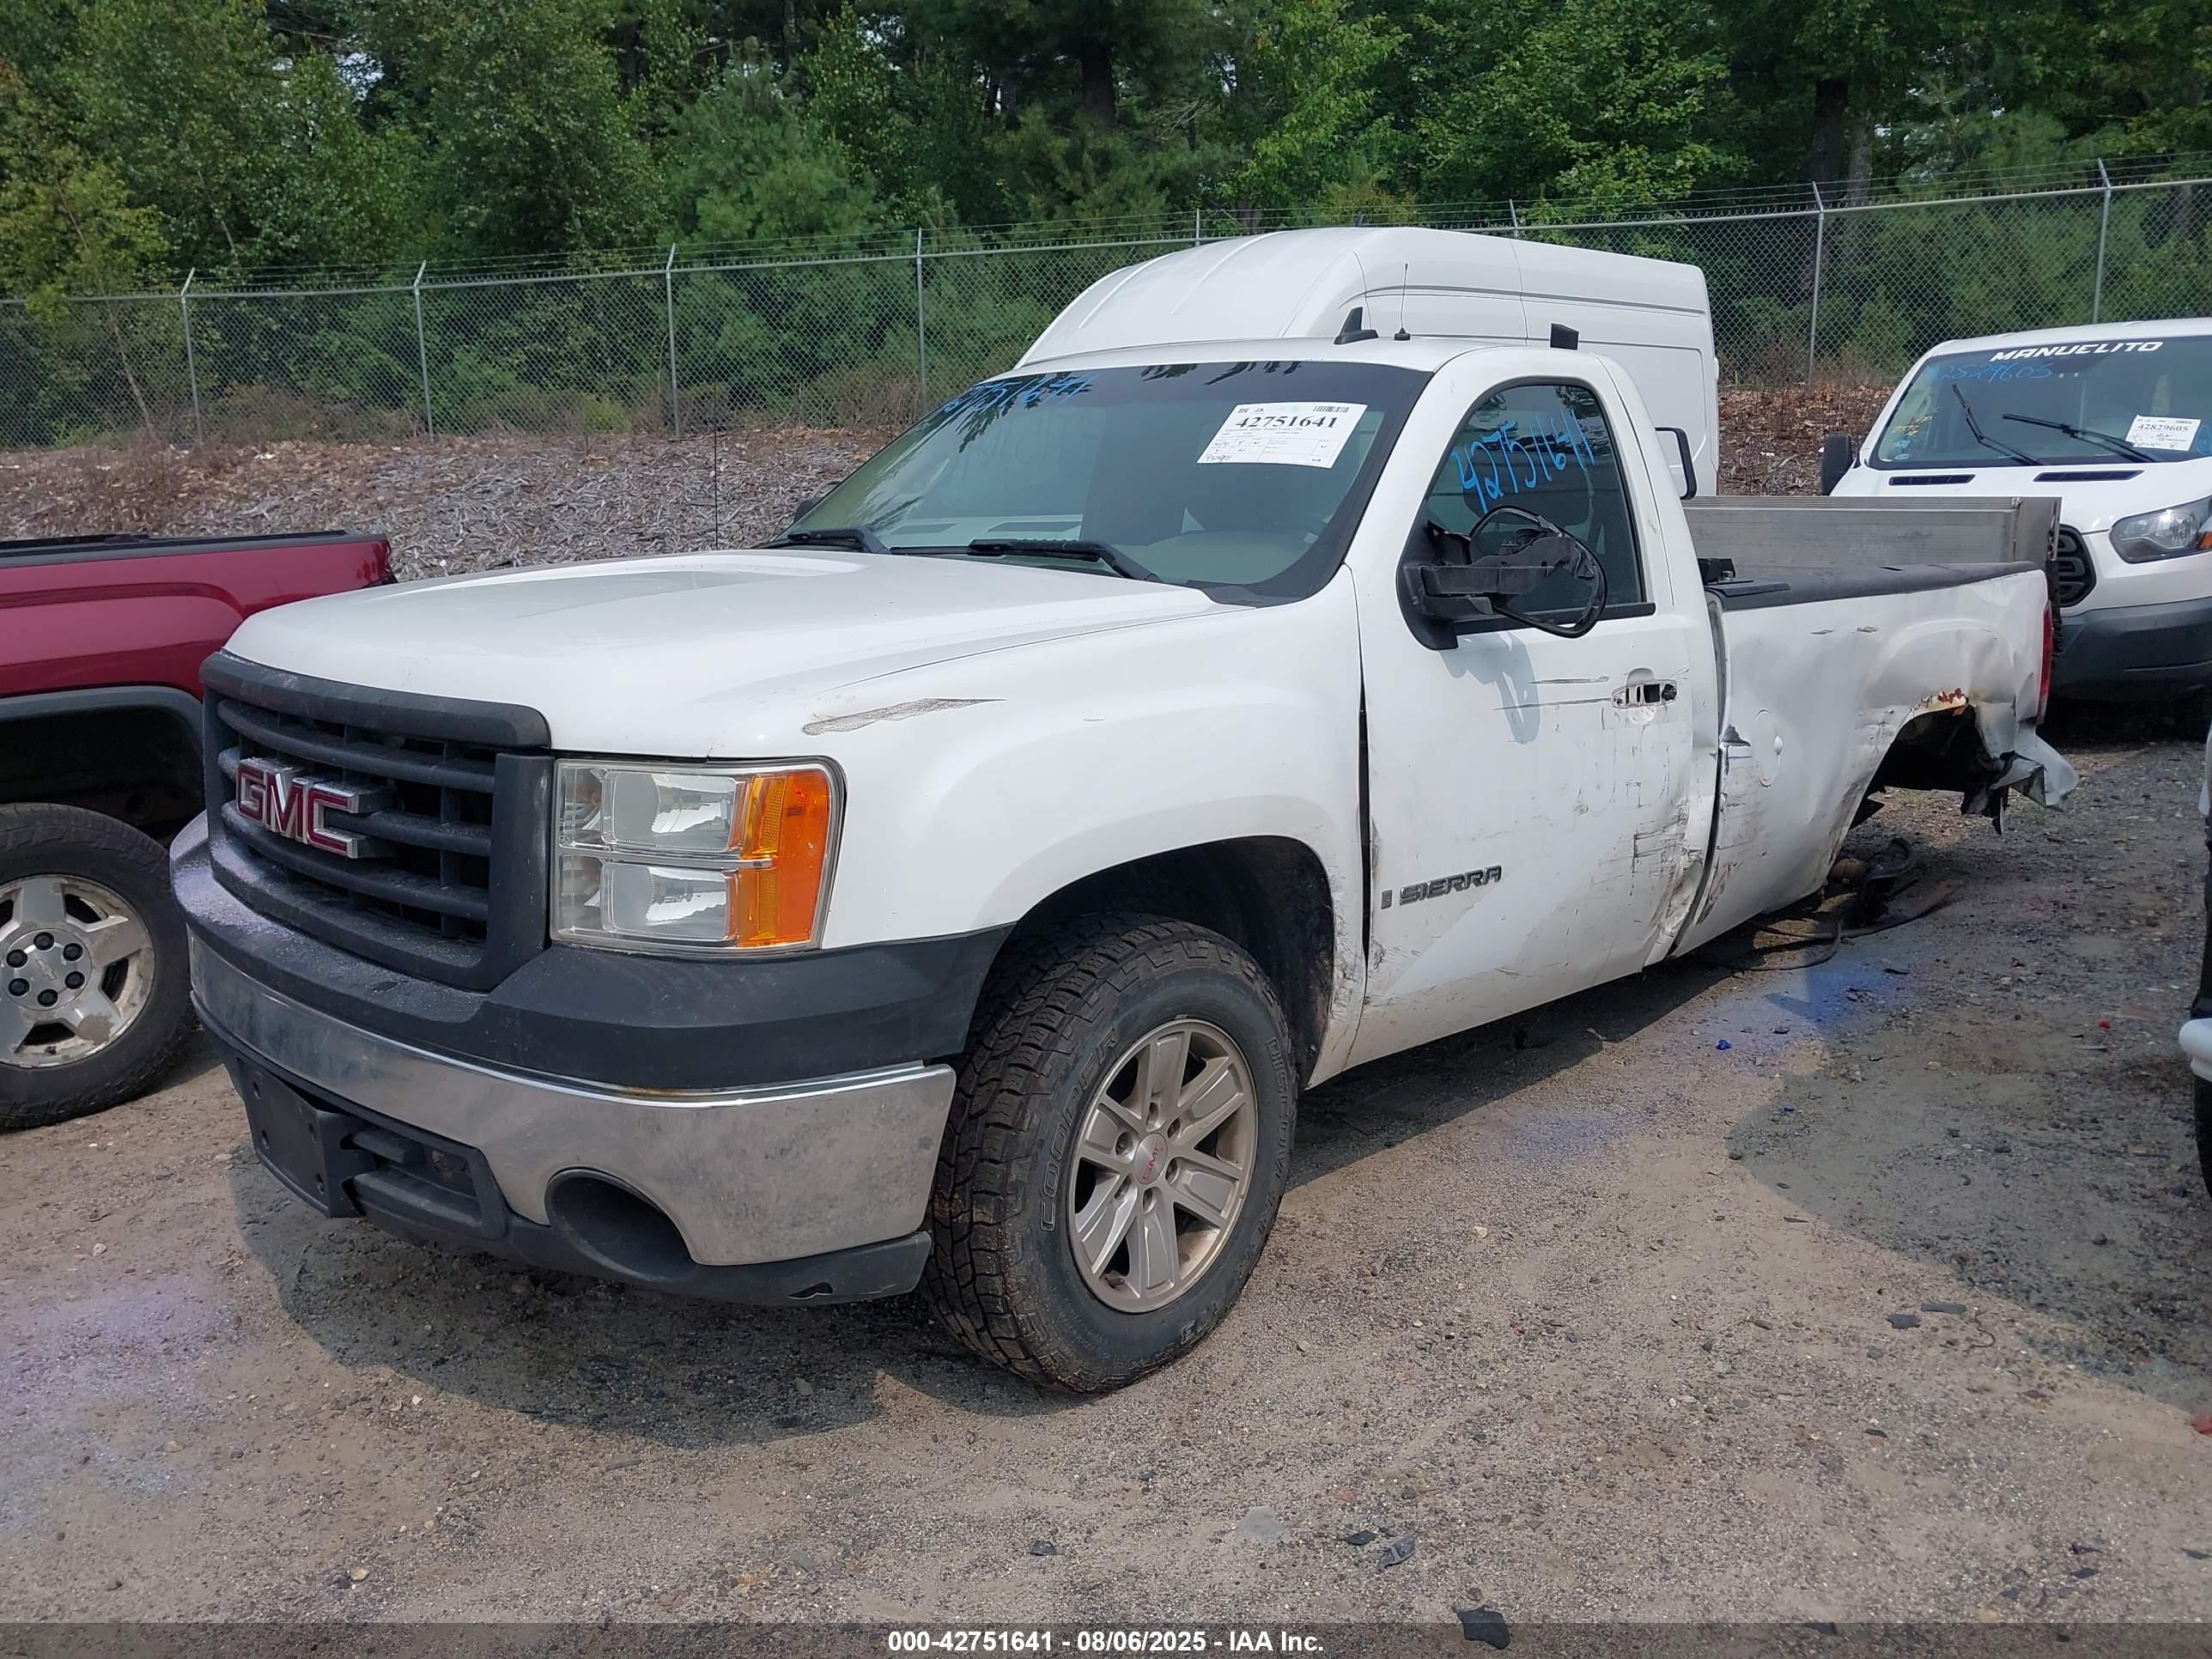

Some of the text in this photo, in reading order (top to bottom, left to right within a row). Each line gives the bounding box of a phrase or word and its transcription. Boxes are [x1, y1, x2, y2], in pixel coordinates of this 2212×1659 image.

[1989, 342, 2163, 362] MANUELITO
[1928, 362, 2054, 383] 2829605
[1236, 416, 1338, 428] 42751641
[2137, 422, 2189, 433] 42829605
[1451, 408, 1595, 514] 42751641
[226, 757, 359, 859] GMC
[1399, 865, 1502, 907] SIERRA
